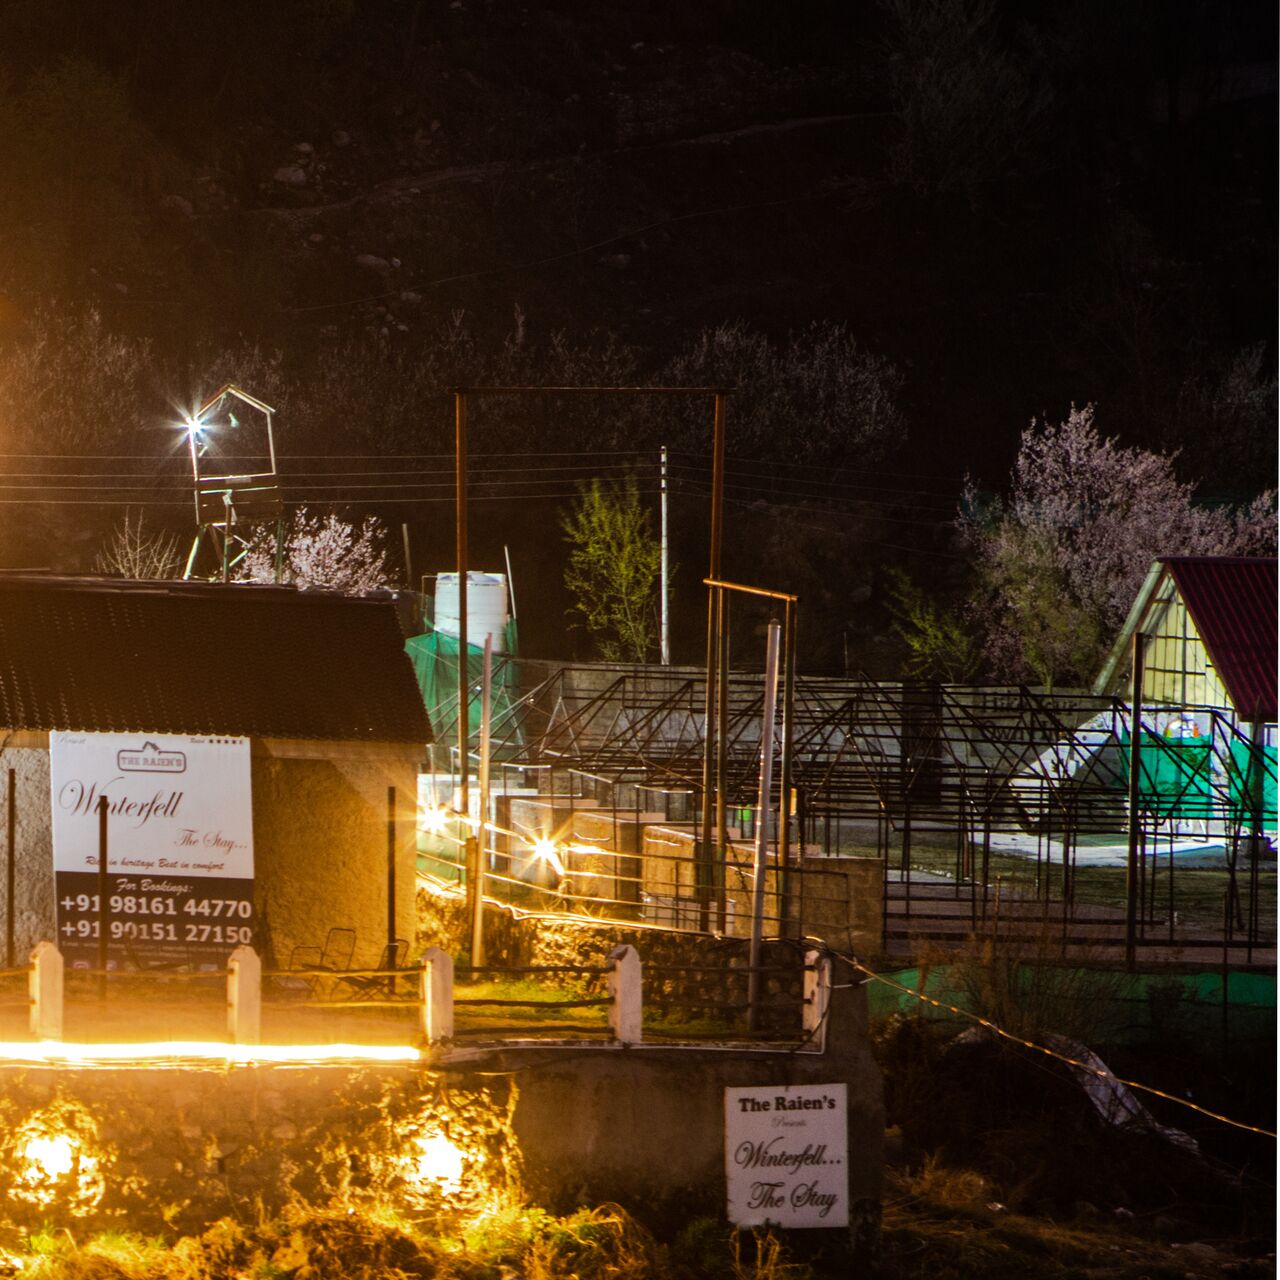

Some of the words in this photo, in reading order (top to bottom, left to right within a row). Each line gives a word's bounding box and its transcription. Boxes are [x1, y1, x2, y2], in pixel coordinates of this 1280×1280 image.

[120, 756, 141, 767] THE
[174, 828, 200, 847] The
[192, 861, 224, 872] comfort
[116, 878, 137, 893] For
[141, 879, 193, 896] Bookings:
[60, 894, 100, 912] +91
[109, 895, 177, 915] 98161
[183, 899, 252, 918] 44770
[61, 920, 100, 938] +91
[110, 921, 178, 940] 90151
[185, 924, 252, 944] 27150
[738, 1097, 770, 1112] The
[774, 1095, 836, 1111] Raien's
[734, 1136, 841, 1176] Winterfell...
[747, 1181, 785, 1210] The
[790, 1180, 838, 1218] Stay
